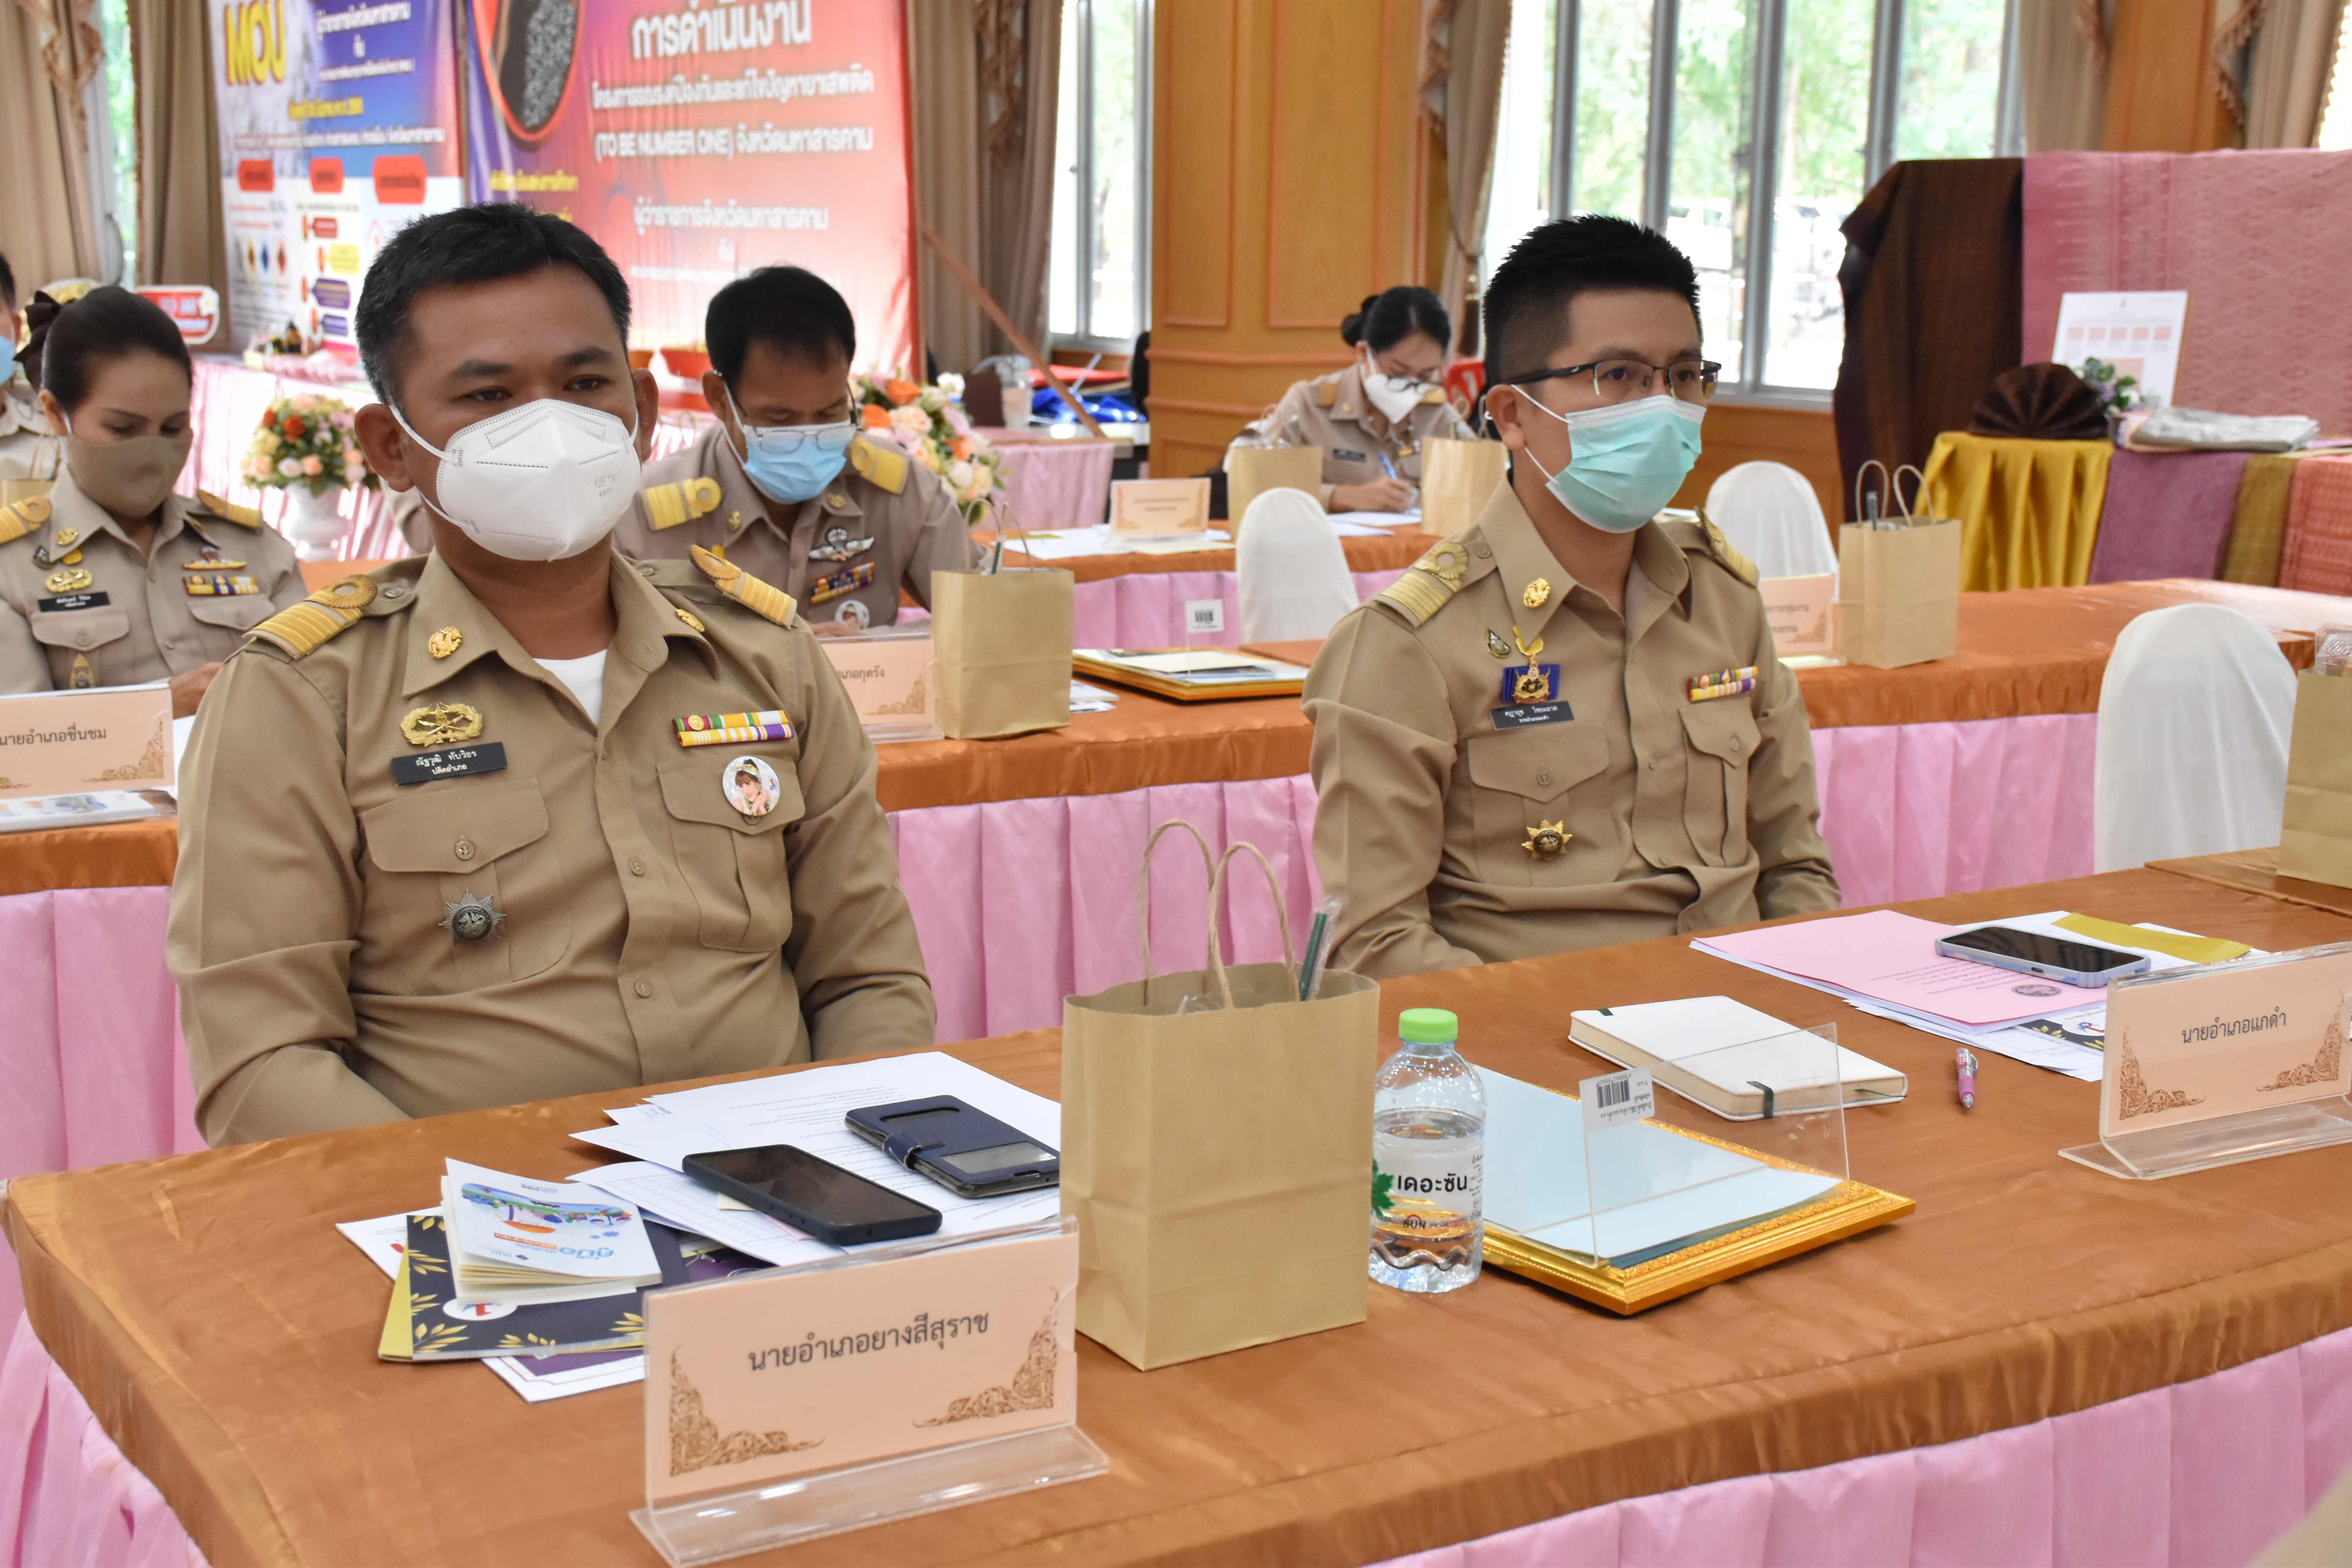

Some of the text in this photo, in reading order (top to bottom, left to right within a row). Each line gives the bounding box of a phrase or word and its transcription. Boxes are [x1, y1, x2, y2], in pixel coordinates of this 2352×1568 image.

[224, 0, 285, 85] MOU
[0, 722, 106, 746] นายอำเภอชื่นชม
[432, 764, 468, 775] ปลัดอำเภอ
[2181, 1006, 2287, 1044] นายอำเภอแกดำ
[1398, 1172, 1468, 1193] เดอะซัน
[559, 1247, 614, 1260] คู่มือ
[748, 1312, 989, 1372] นายอำเภอยางสีสุราช
